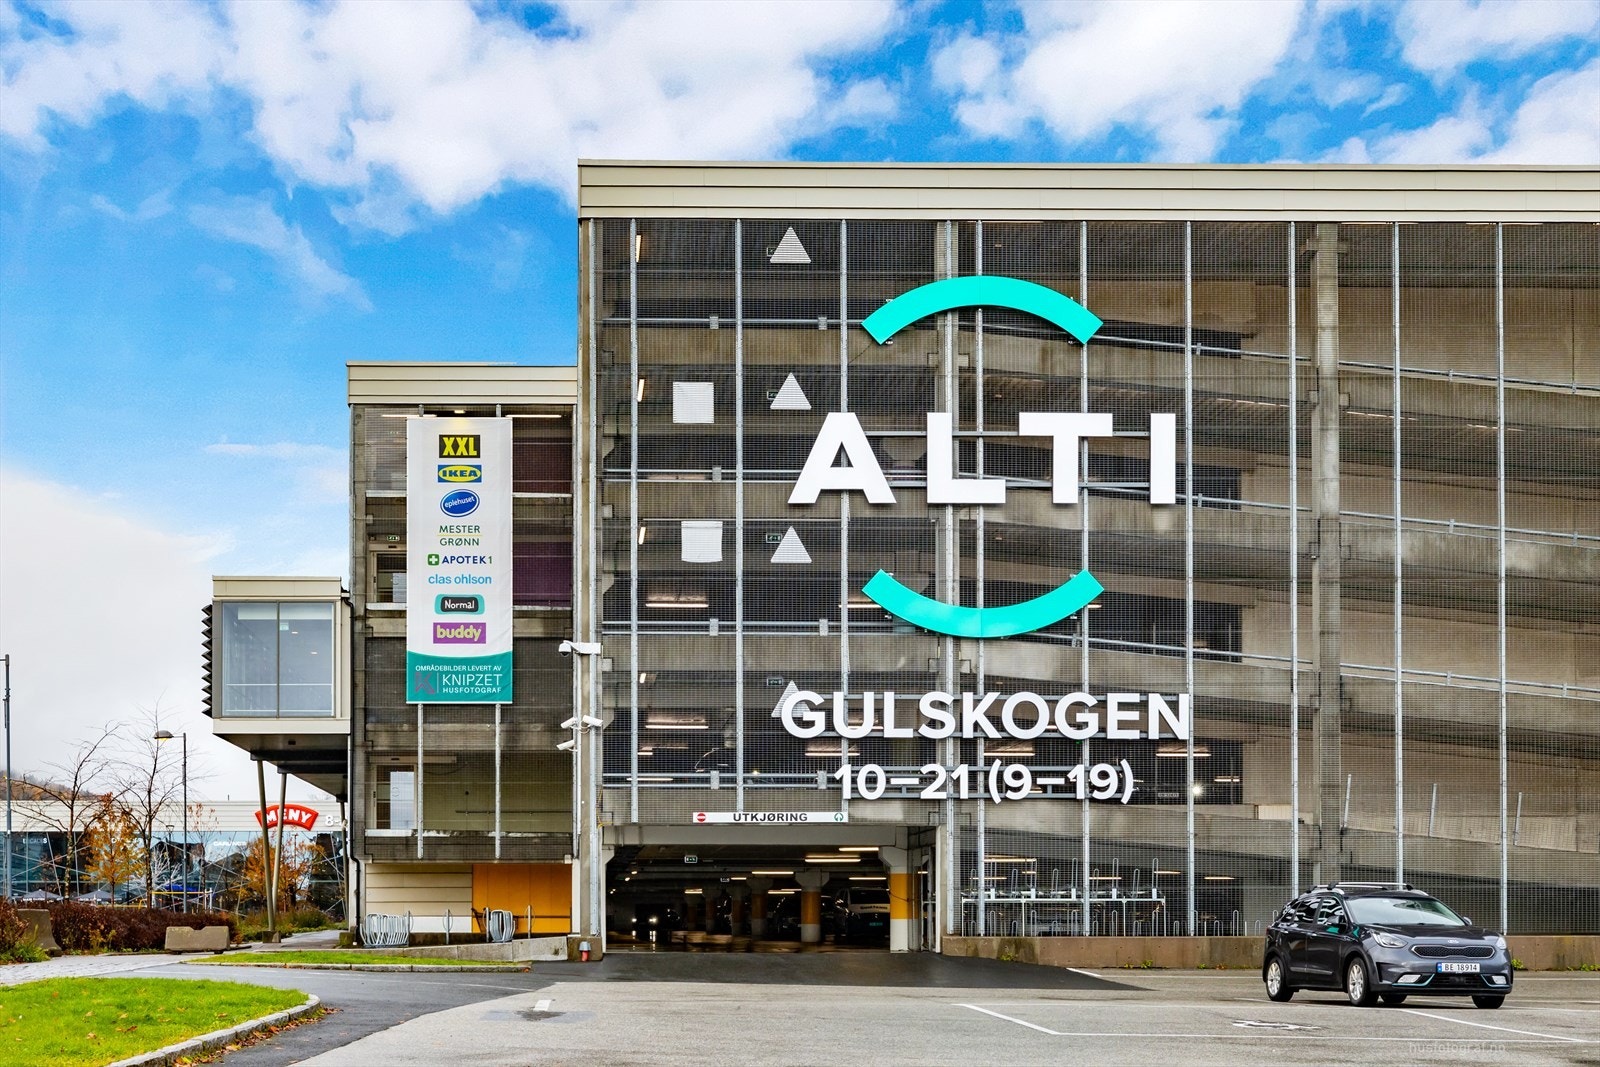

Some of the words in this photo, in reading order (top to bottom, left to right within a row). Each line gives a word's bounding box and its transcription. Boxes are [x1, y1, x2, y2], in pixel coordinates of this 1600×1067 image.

[442, 437, 478, 456] XXL
[787, 412, 1176, 504] ALTI
[442, 469, 478, 478] IKEA
[444, 495, 476, 509] eplehuset
[439, 525, 481, 534] MESTER
[439, 537, 480, 546] GRØNN
[442, 555, 487, 565] APOTEK
[488, 555, 493, 565] 1
[428, 574, 452, 585] clas
[454, 574, 492, 585] ohlson
[444, 599, 475, 610] Normal
[436, 624, 482, 641] buddy
[415, 664, 467, 672] OMRÅDEBILDER
[442, 673, 503, 686] KNIPZET
[781, 690, 1189, 740] GULSKOGEN
[732, 812, 808, 822] UTKJØRING
[1444, 963, 1454, 971] BE
[1457, 964, 1478, 972] 18914
